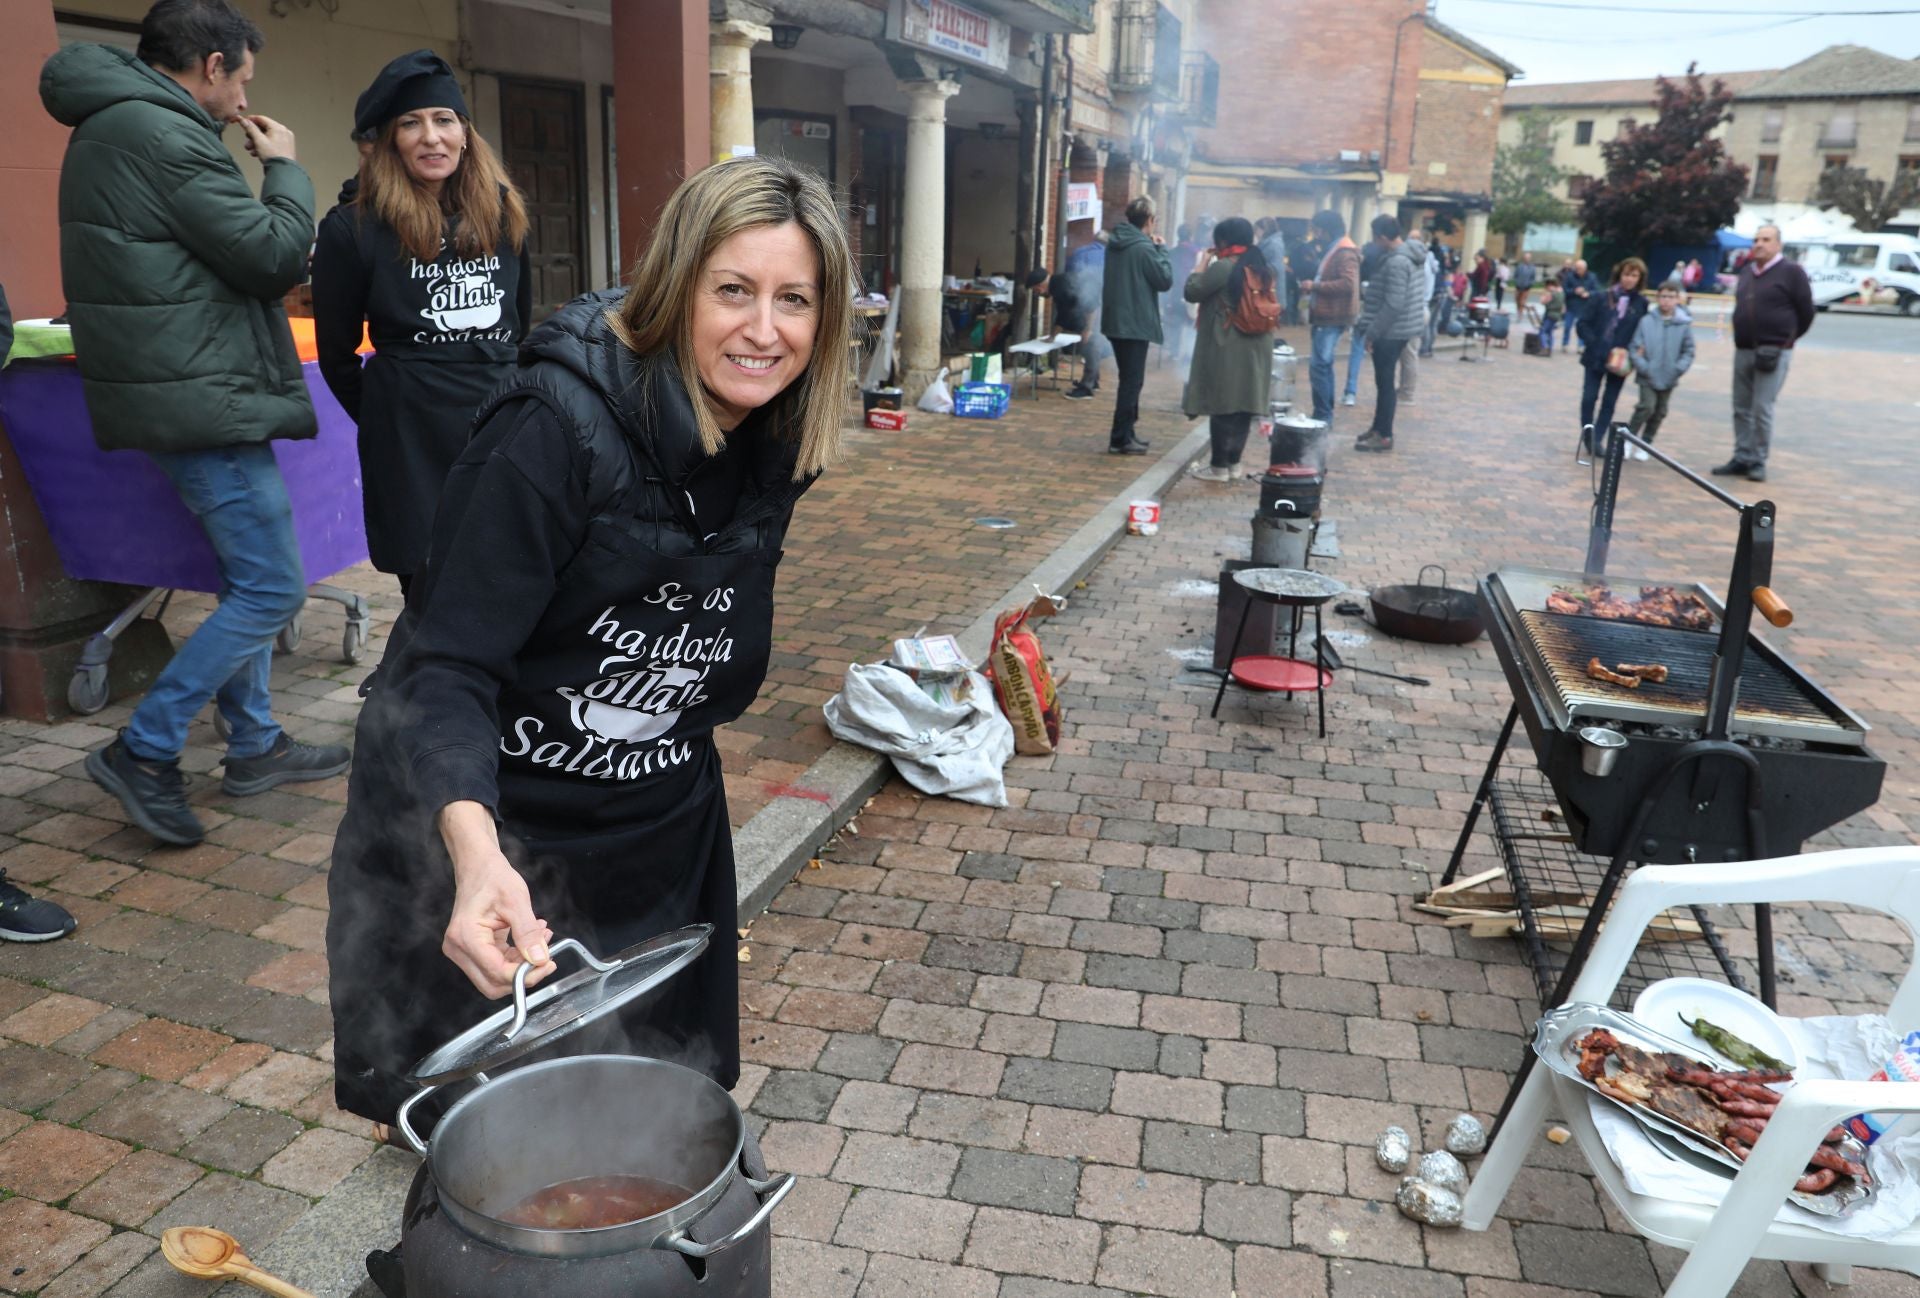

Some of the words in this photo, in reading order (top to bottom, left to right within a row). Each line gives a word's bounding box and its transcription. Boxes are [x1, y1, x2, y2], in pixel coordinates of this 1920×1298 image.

[410, 257, 440, 279] ha
[445, 256, 477, 277] ido
[484, 253, 501, 272] la
[642, 582, 693, 612] Se
[702, 587, 735, 612] os
[587, 605, 647, 656] ha
[650, 623, 702, 664] ido
[706, 626, 734, 664] la
